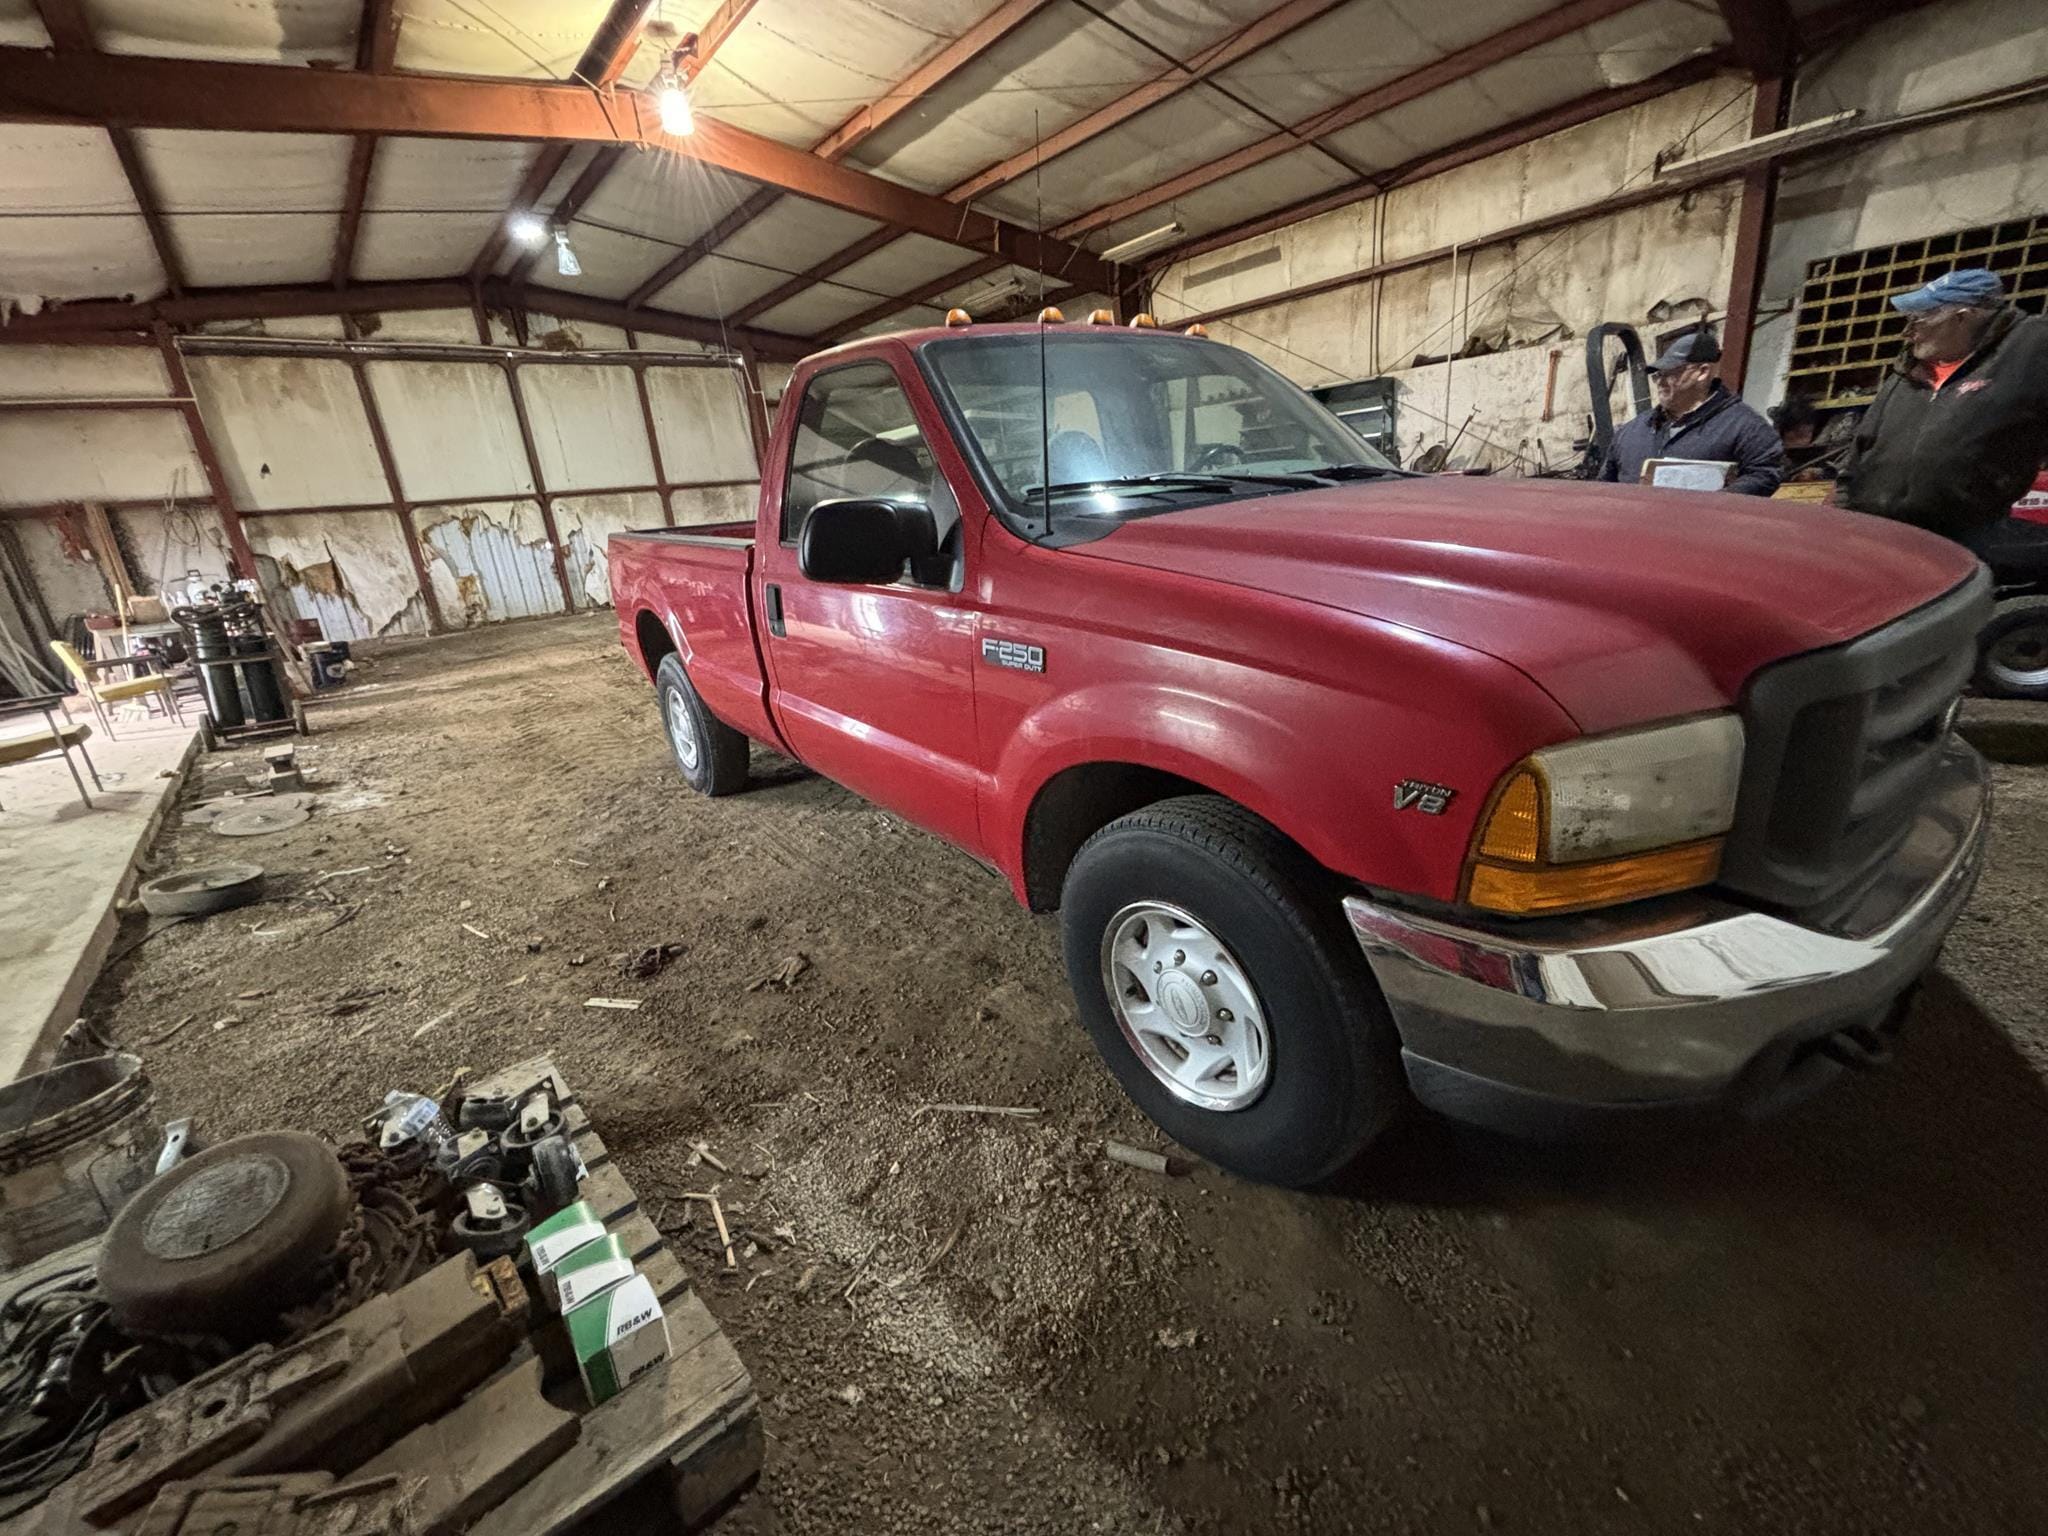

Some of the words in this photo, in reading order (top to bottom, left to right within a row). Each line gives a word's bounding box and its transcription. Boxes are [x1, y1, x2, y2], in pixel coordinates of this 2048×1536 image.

[1002, 659, 1023, 669] SUPER
[1024, 663, 1042, 672] DUTY
[1394, 785, 1446, 814] V8
[1402, 779, 1452, 798] TRITON
[617, 1307, 652, 1336] RB&W
